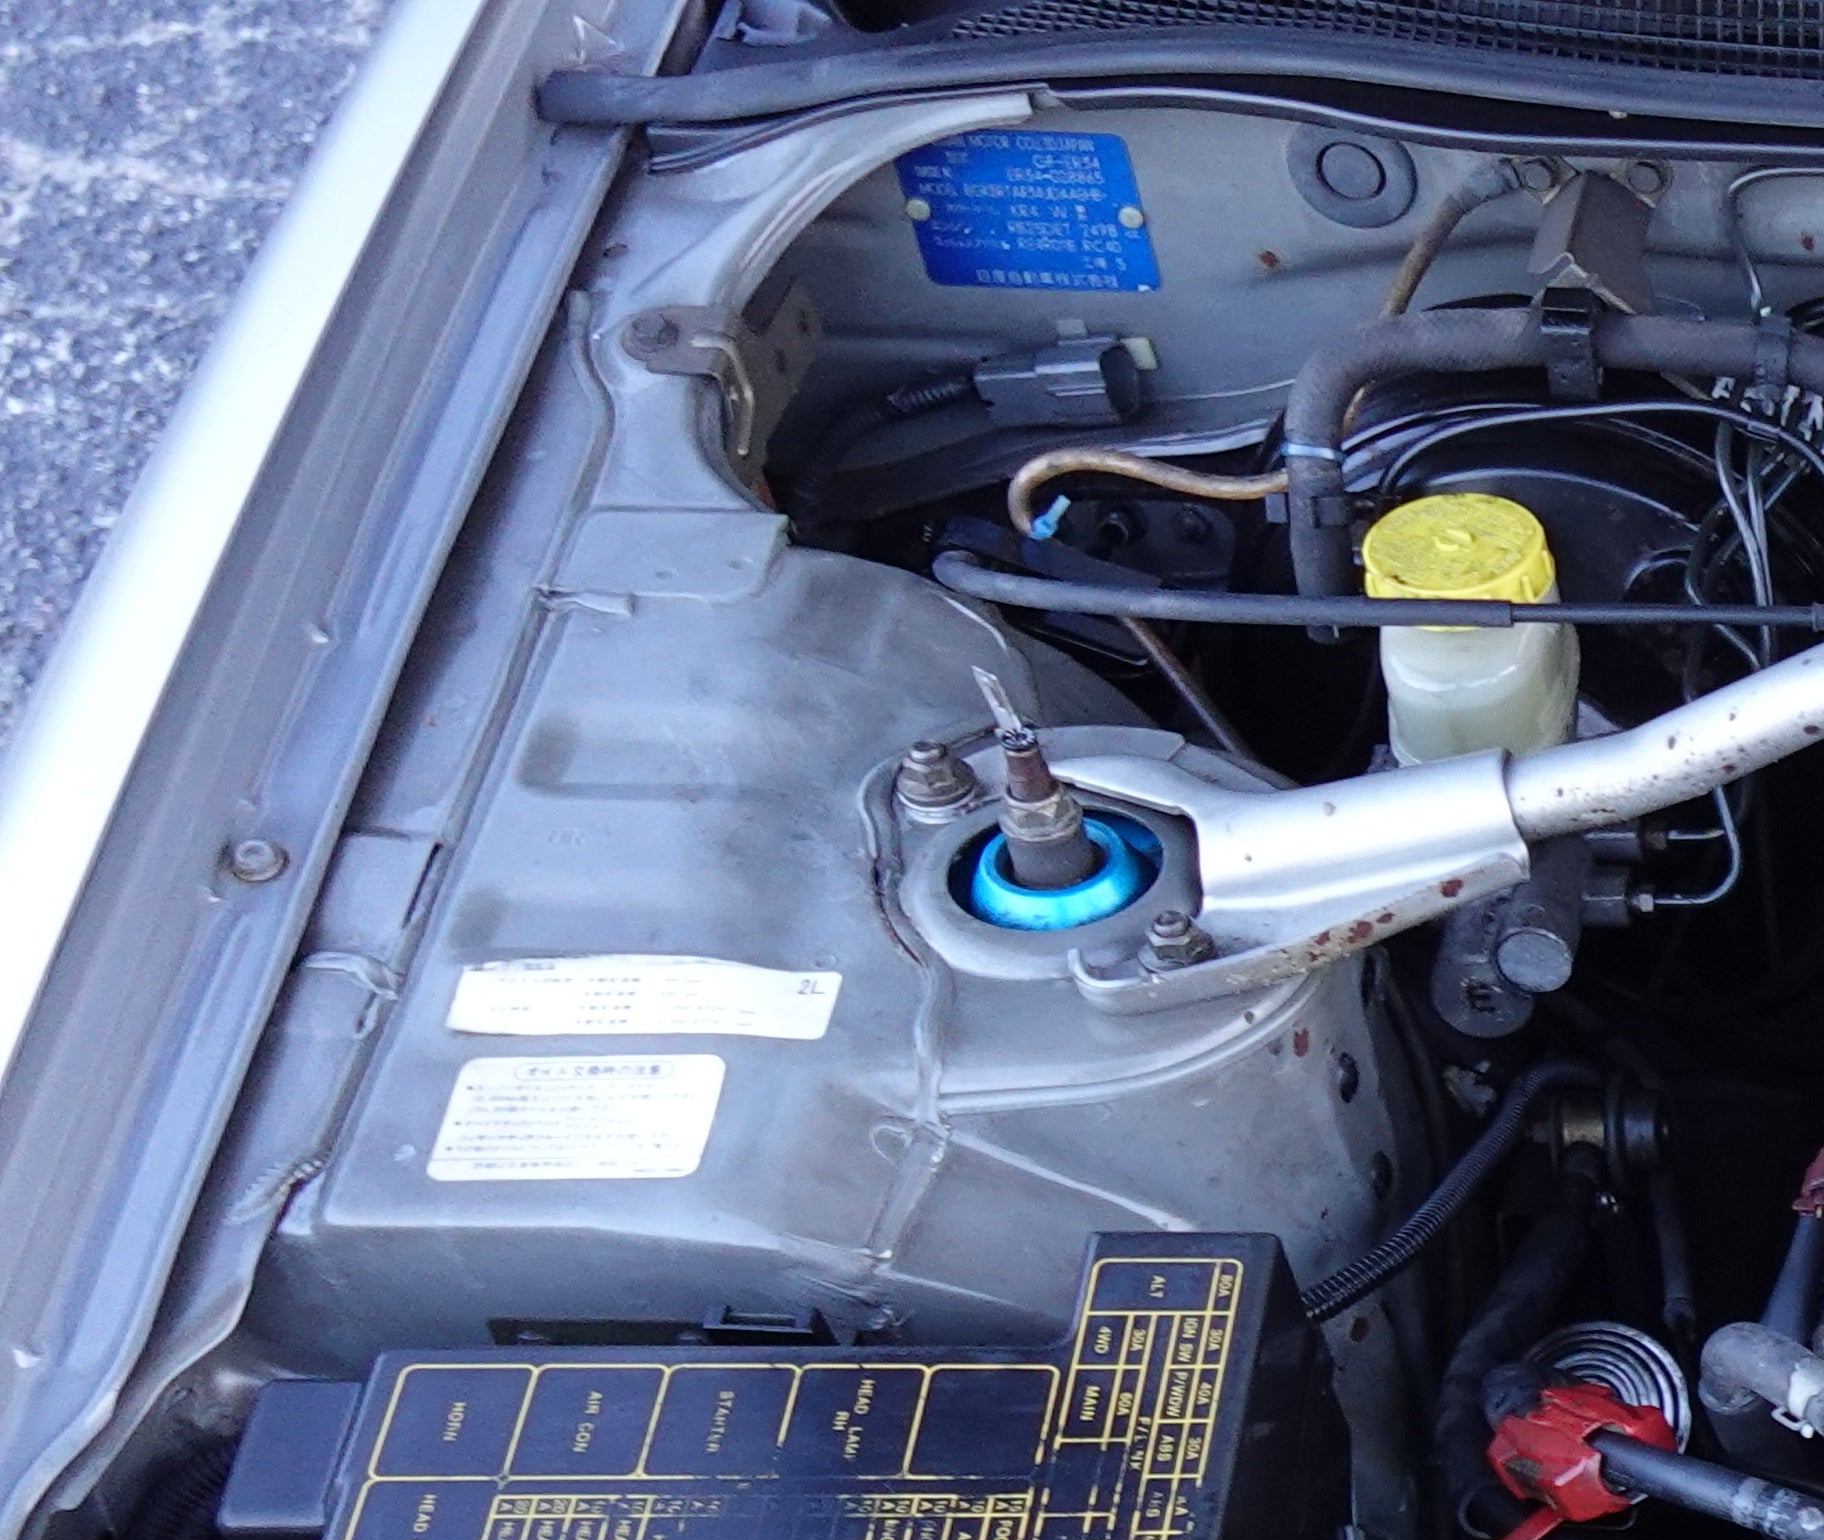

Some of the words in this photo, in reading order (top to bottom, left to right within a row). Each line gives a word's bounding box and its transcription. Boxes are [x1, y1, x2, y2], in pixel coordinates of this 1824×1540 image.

[1150, 1275, 1166, 1298] ALT
[1093, 1326, 1112, 1354] 4WD
[1182, 1317, 1200, 1339] IGN
[584, 1390, 604, 1415] AIR
[853, 1378, 876, 1415] HEAD
[1079, 1385, 1101, 1421] MAIN
[1167, 1371, 1189, 1418] P/WDW
[1197, 1382, 1213, 1405] 40A
[442, 1401, 468, 1442] HORN
[572, 1421, 595, 1453] CON
[1156, 1434, 1175, 1462] ABS
[1186, 1436, 1202, 1460] 30A
[412, 1493, 439, 1533] HEAD
[881, 1500, 896, 1511] A
[918, 1500, 934, 1511] A
[995, 1501, 1009, 1511] A
